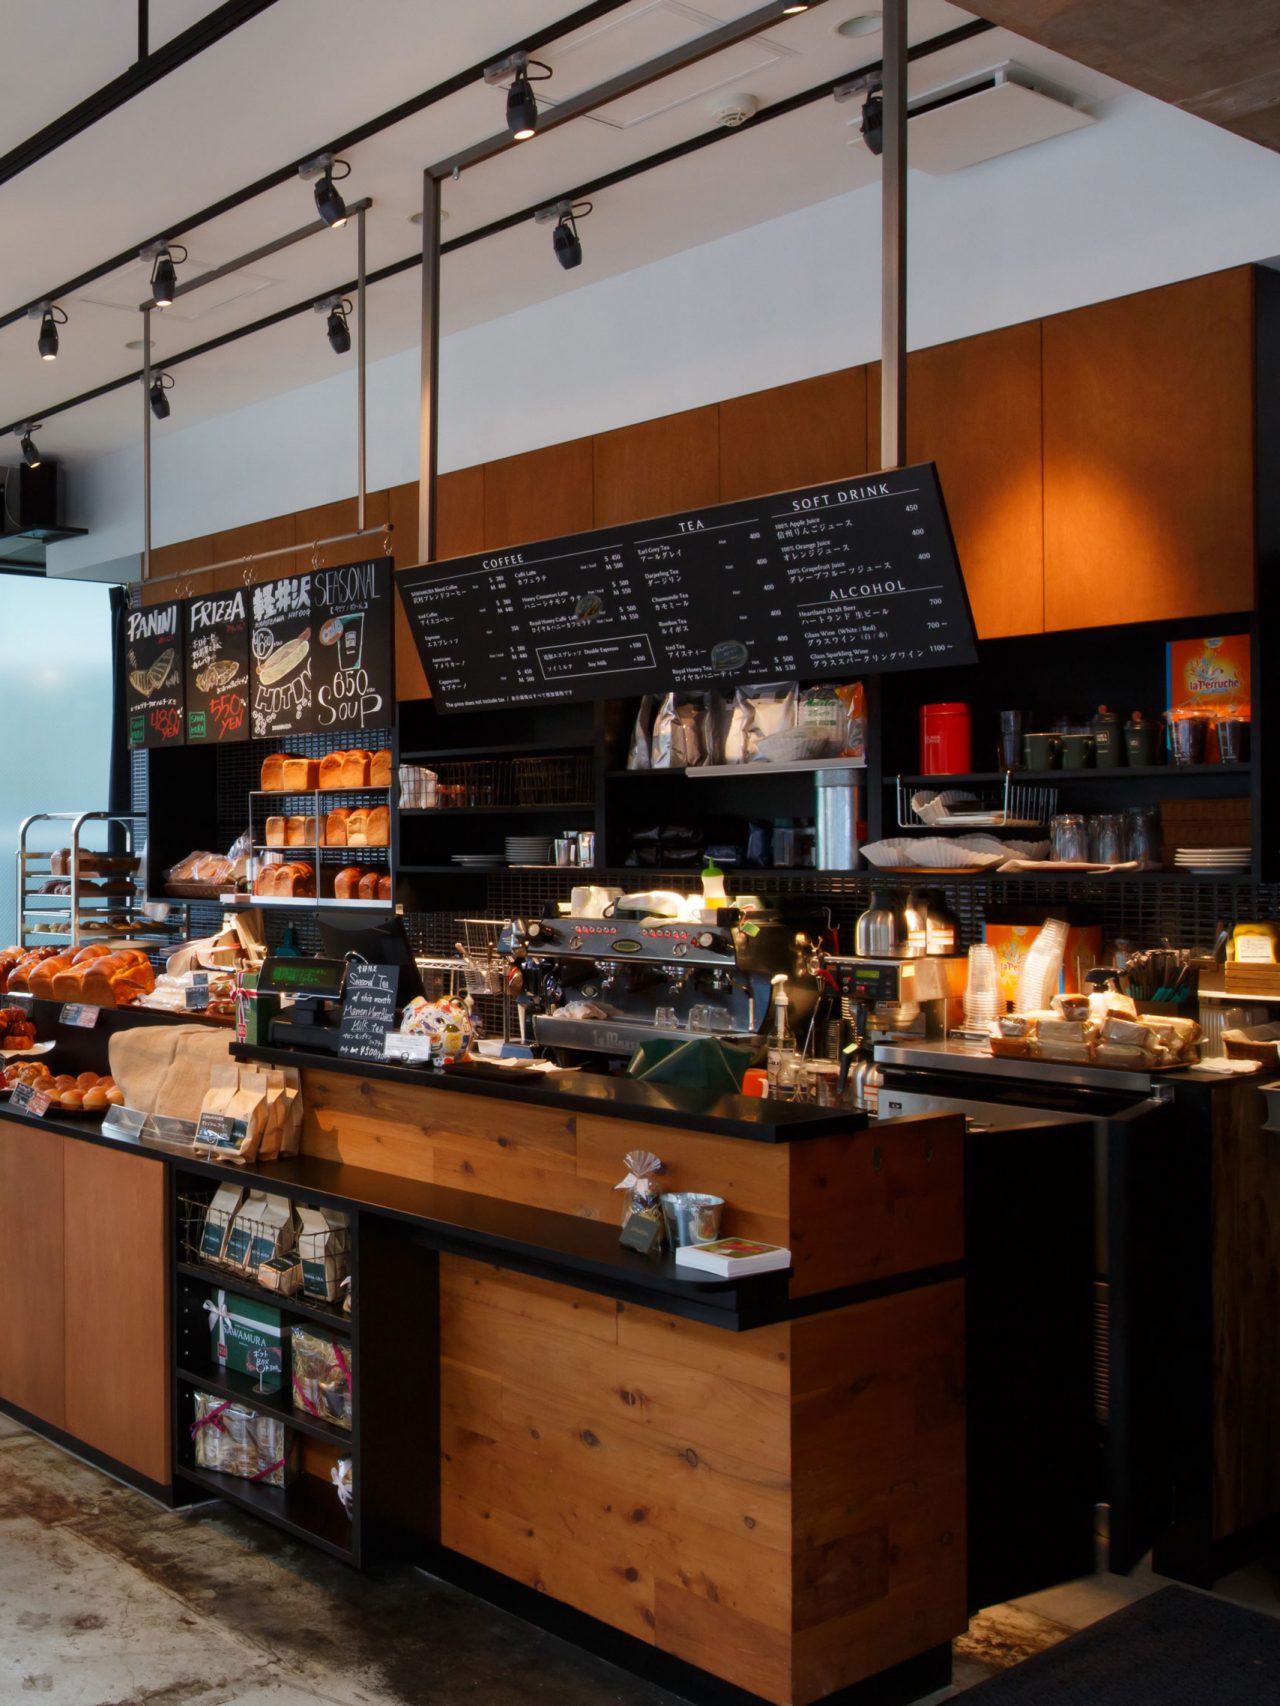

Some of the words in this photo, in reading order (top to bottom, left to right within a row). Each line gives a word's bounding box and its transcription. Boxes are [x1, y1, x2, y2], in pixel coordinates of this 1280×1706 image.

[792, 494, 831, 512] SOFT
[837, 483, 890, 503] DRINK
[905, 504, 918, 512] 450
[678, 519, 705, 533] TEA
[774, 522, 789, 530] 100%
[789, 520, 805, 528] Apple
[806, 517, 820, 526] Juice
[777, 519, 853, 540] 信州りんごジュース
[911, 528, 925, 536] 400
[781, 545, 795, 553] 100%
[795, 543, 816, 551] Orange
[816, 540, 831, 548] Juice
[783, 544, 850, 562] オレンジジュース
[482, 553, 524, 570] COFFEE
[640, 549, 681, 562] アールグレイ
[918, 552, 931, 560] 400
[787, 568, 801, 576] 100%
[801, 563, 830, 574] Grapefruit
[831, 561, 845, 569] Juice
[789, 562, 892, 584] グレープフルーツジュース
[314, 563, 381, 607] SEASONAL
[517, 575, 547, 586] カフェラテ
[648, 575, 682, 587] ダージリン
[763, 583, 775, 591] 400
[829, 580, 907, 600] ALCOHOL
[253, 575, 311, 622] 軽井沢
[929, 598, 942, 606] 700
[190, 591, 246, 633] FRIZZA
[655, 600, 689, 611] カモミール
[798, 609, 827, 618] Heartland
[843, 604, 856, 612] Beer
[770, 609, 782, 617] 400
[801, 614, 851, 625] ハートランド
[855, 608, 890, 620] 生ビール
[128, 605, 177, 642] PANINI
[420, 616, 455, 626] アイスコーヒー
[927, 621, 940, 629] 700
[661, 625, 689, 635] ルイボス
[804, 631, 820, 639] Glass
[427, 638, 459, 648] エスプレッソ
[808, 635, 856, 647] グラスワイン
[668, 650, 707, 659] アイスティー
[810, 652, 826, 660] Glass
[826, 649, 853, 658] Sparkling
[853, 648, 869, 656] Wine
[929, 644, 945, 652] 1100
[434, 660, 465, 670] アメリカーノ
[813, 650, 924, 668] グラススパークリングワイン
[674, 671, 741, 682] ロイヤルハニーティー
[333, 669, 368, 698] 650
[441, 683, 467, 692] カプチーノ
[1198, 679, 1239, 690] Perruche
[209, 693, 241, 722] 550
[151, 708, 177, 731] 480
[219, 706, 244, 740] YEN
[378, 974, 389, 988] Tea
[223, 1325, 267, 1347] SAWAMURA
